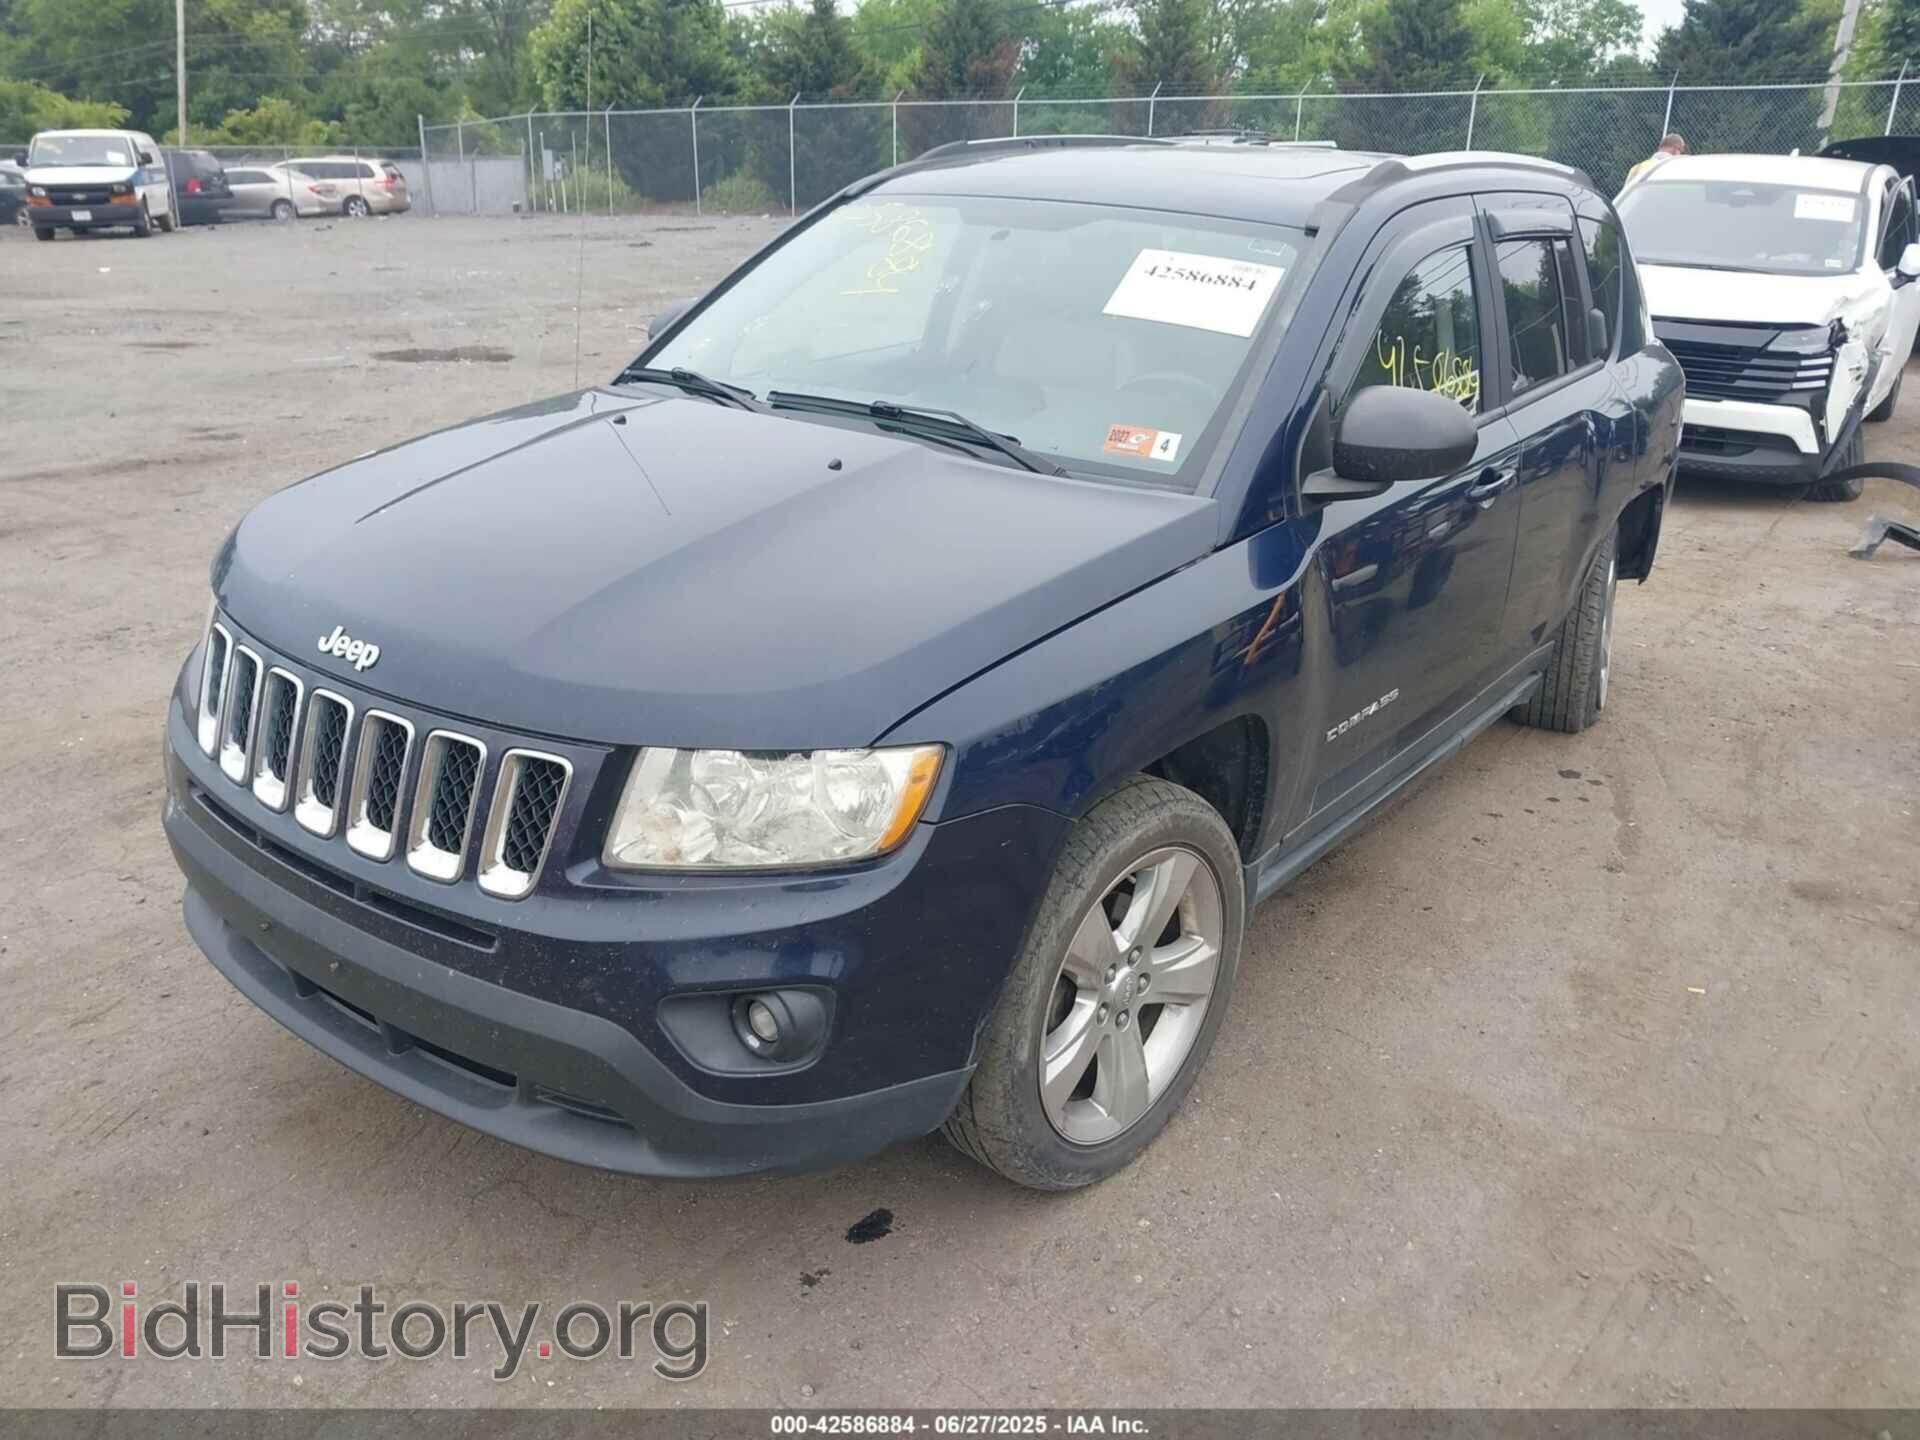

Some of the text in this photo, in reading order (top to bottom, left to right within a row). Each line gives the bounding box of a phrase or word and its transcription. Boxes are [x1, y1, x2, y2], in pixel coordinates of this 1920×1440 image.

[1143, 265, 1257, 291] 42586884
[1160, 438, 1170, 453] 4
[318, 625, 380, 671] Jeep
